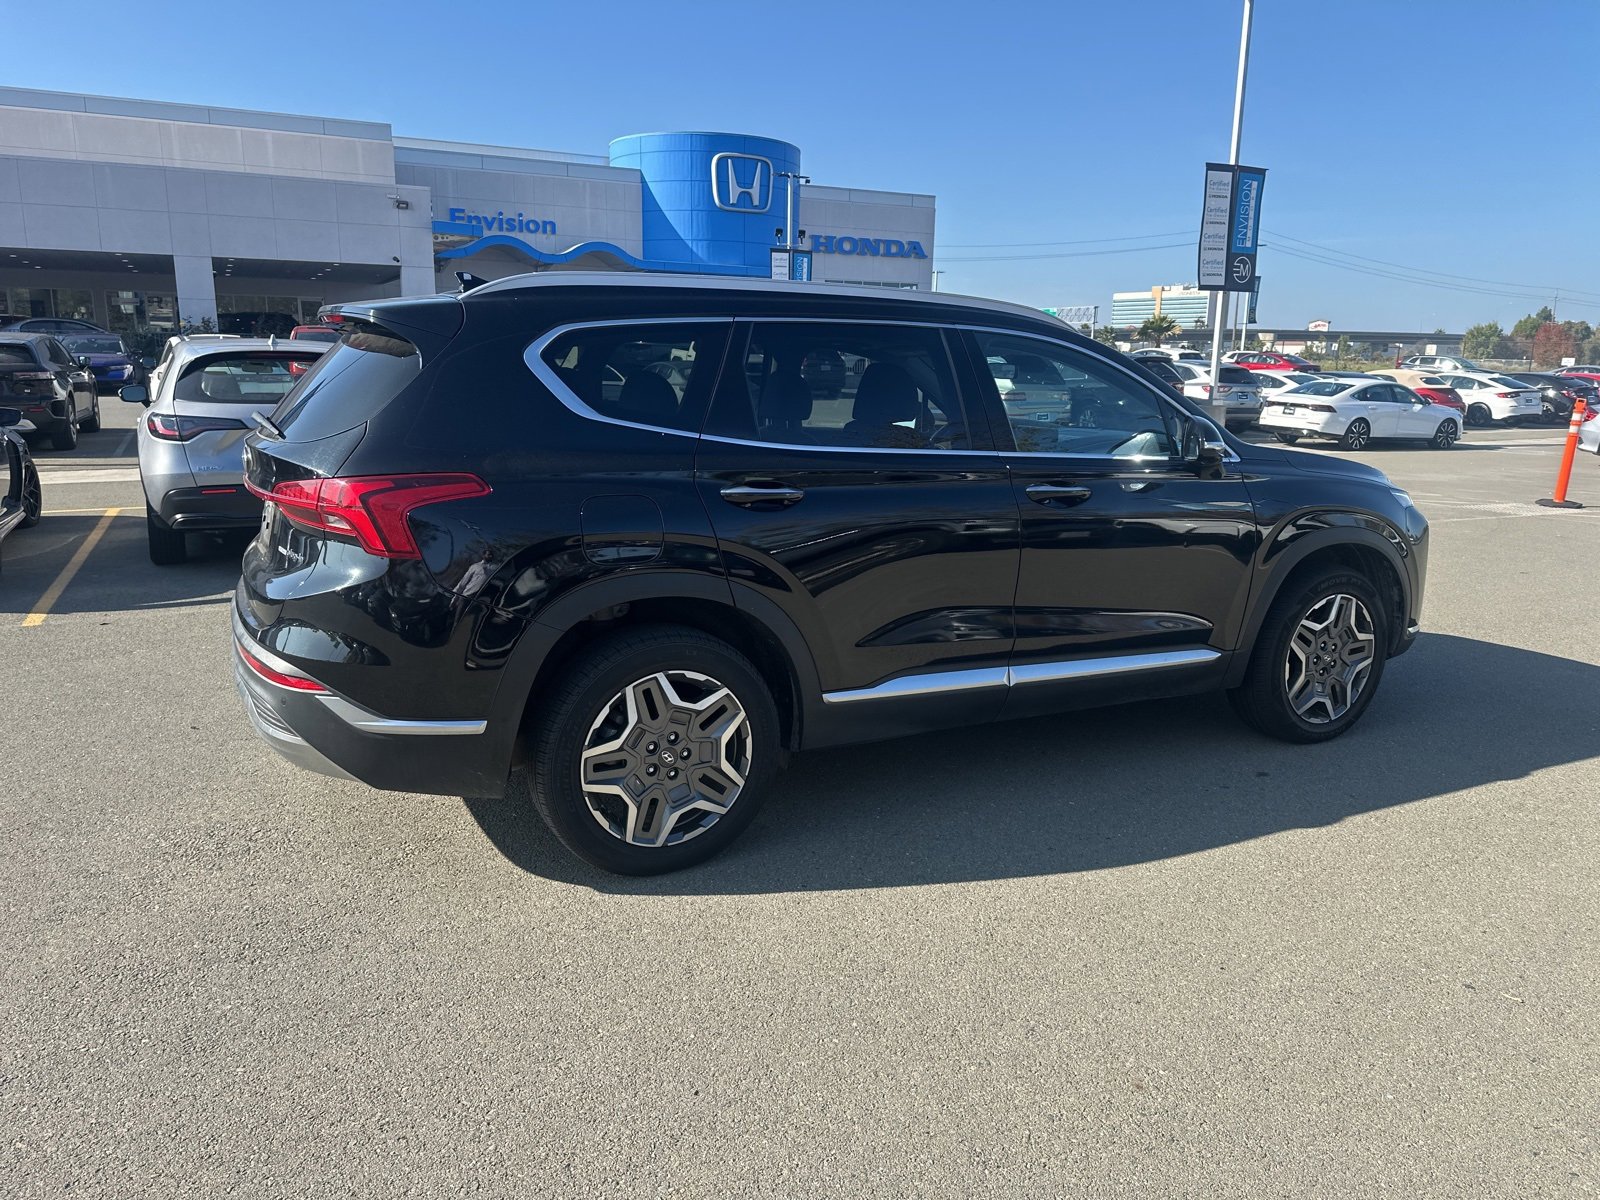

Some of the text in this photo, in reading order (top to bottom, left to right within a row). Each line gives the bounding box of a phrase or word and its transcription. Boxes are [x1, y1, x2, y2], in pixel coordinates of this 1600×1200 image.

[449, 207, 557, 235] Envision
[1206, 206, 1228, 214] Certified
[1236, 180, 1252, 247] ENVISION
[809, 234, 929, 259] HONDA
[1204, 232, 1226, 240] Certified
